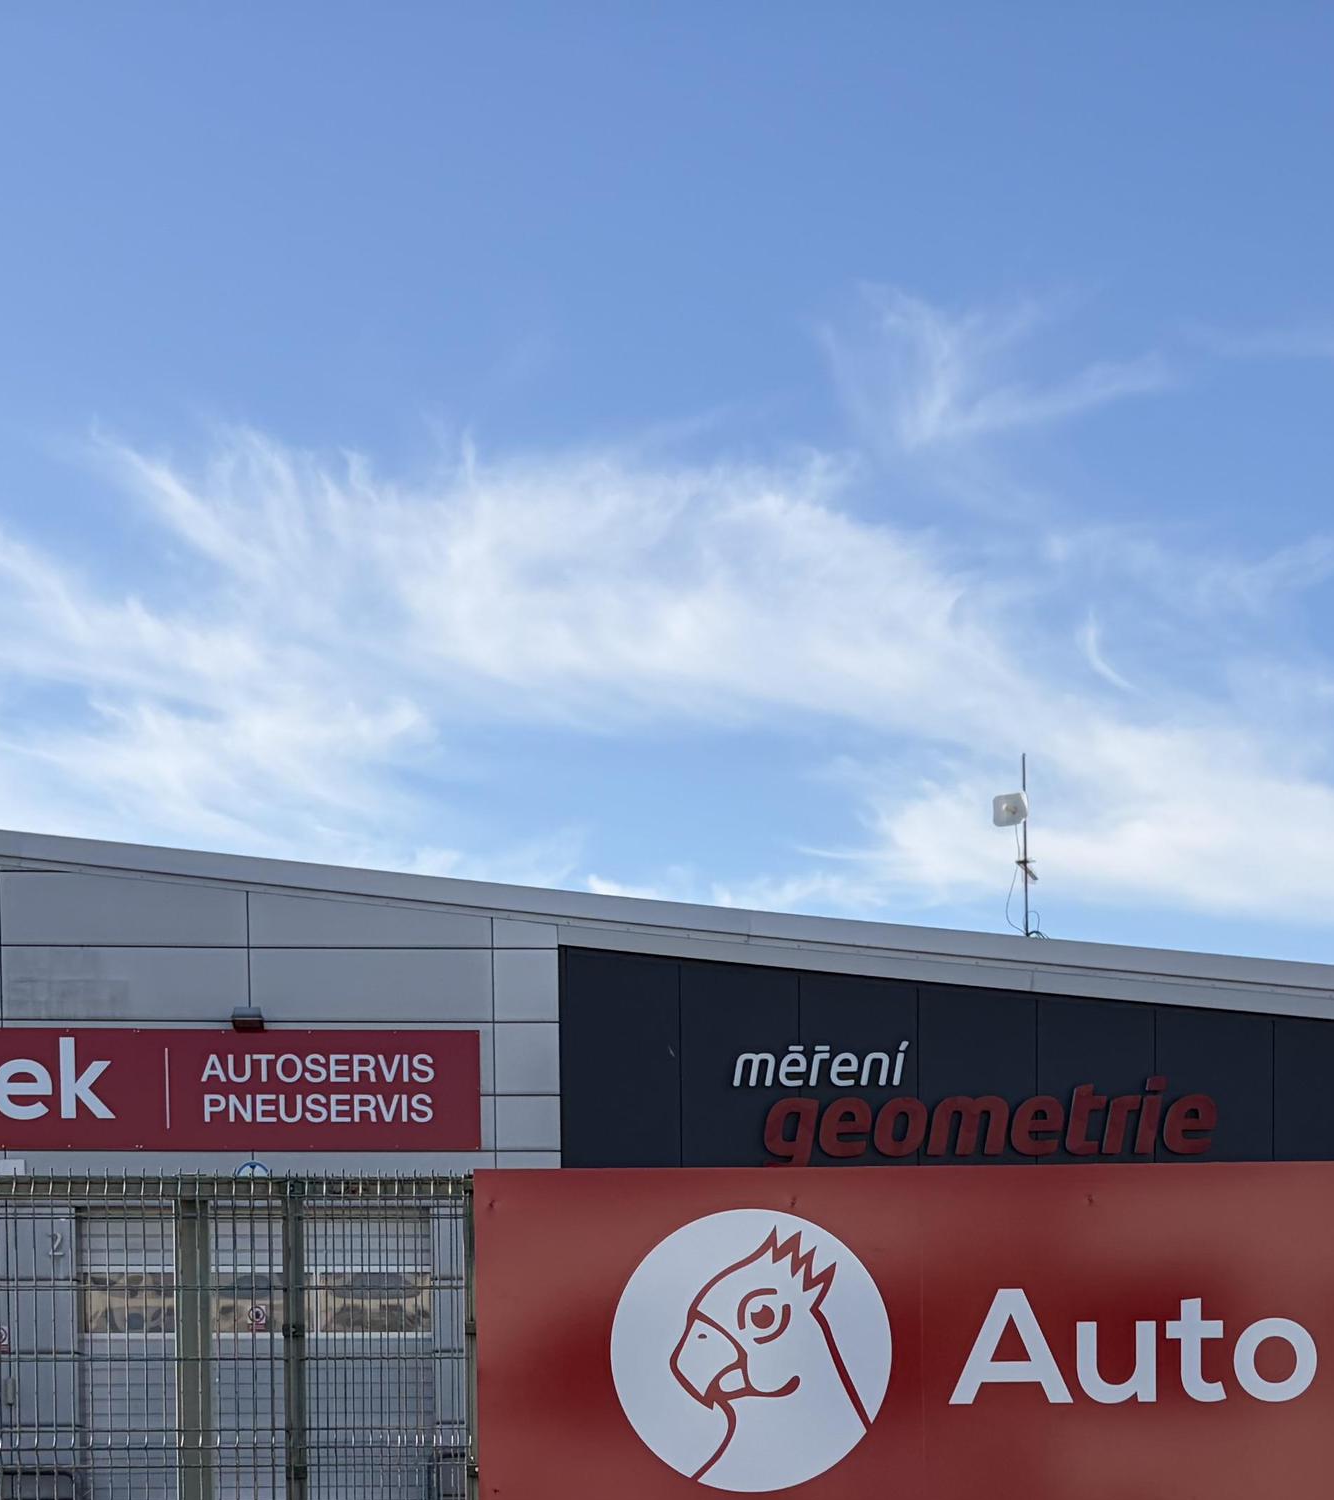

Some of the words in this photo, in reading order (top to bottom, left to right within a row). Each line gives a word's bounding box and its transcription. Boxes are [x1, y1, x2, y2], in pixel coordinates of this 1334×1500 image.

[200, 1053, 435, 1083] AUTOSERVIS
[203, 1093, 434, 1123] PNEUSERVIS
[763, 1075, 1218, 1167] geometrie
[948, 1288, 1318, 1405] Auto
